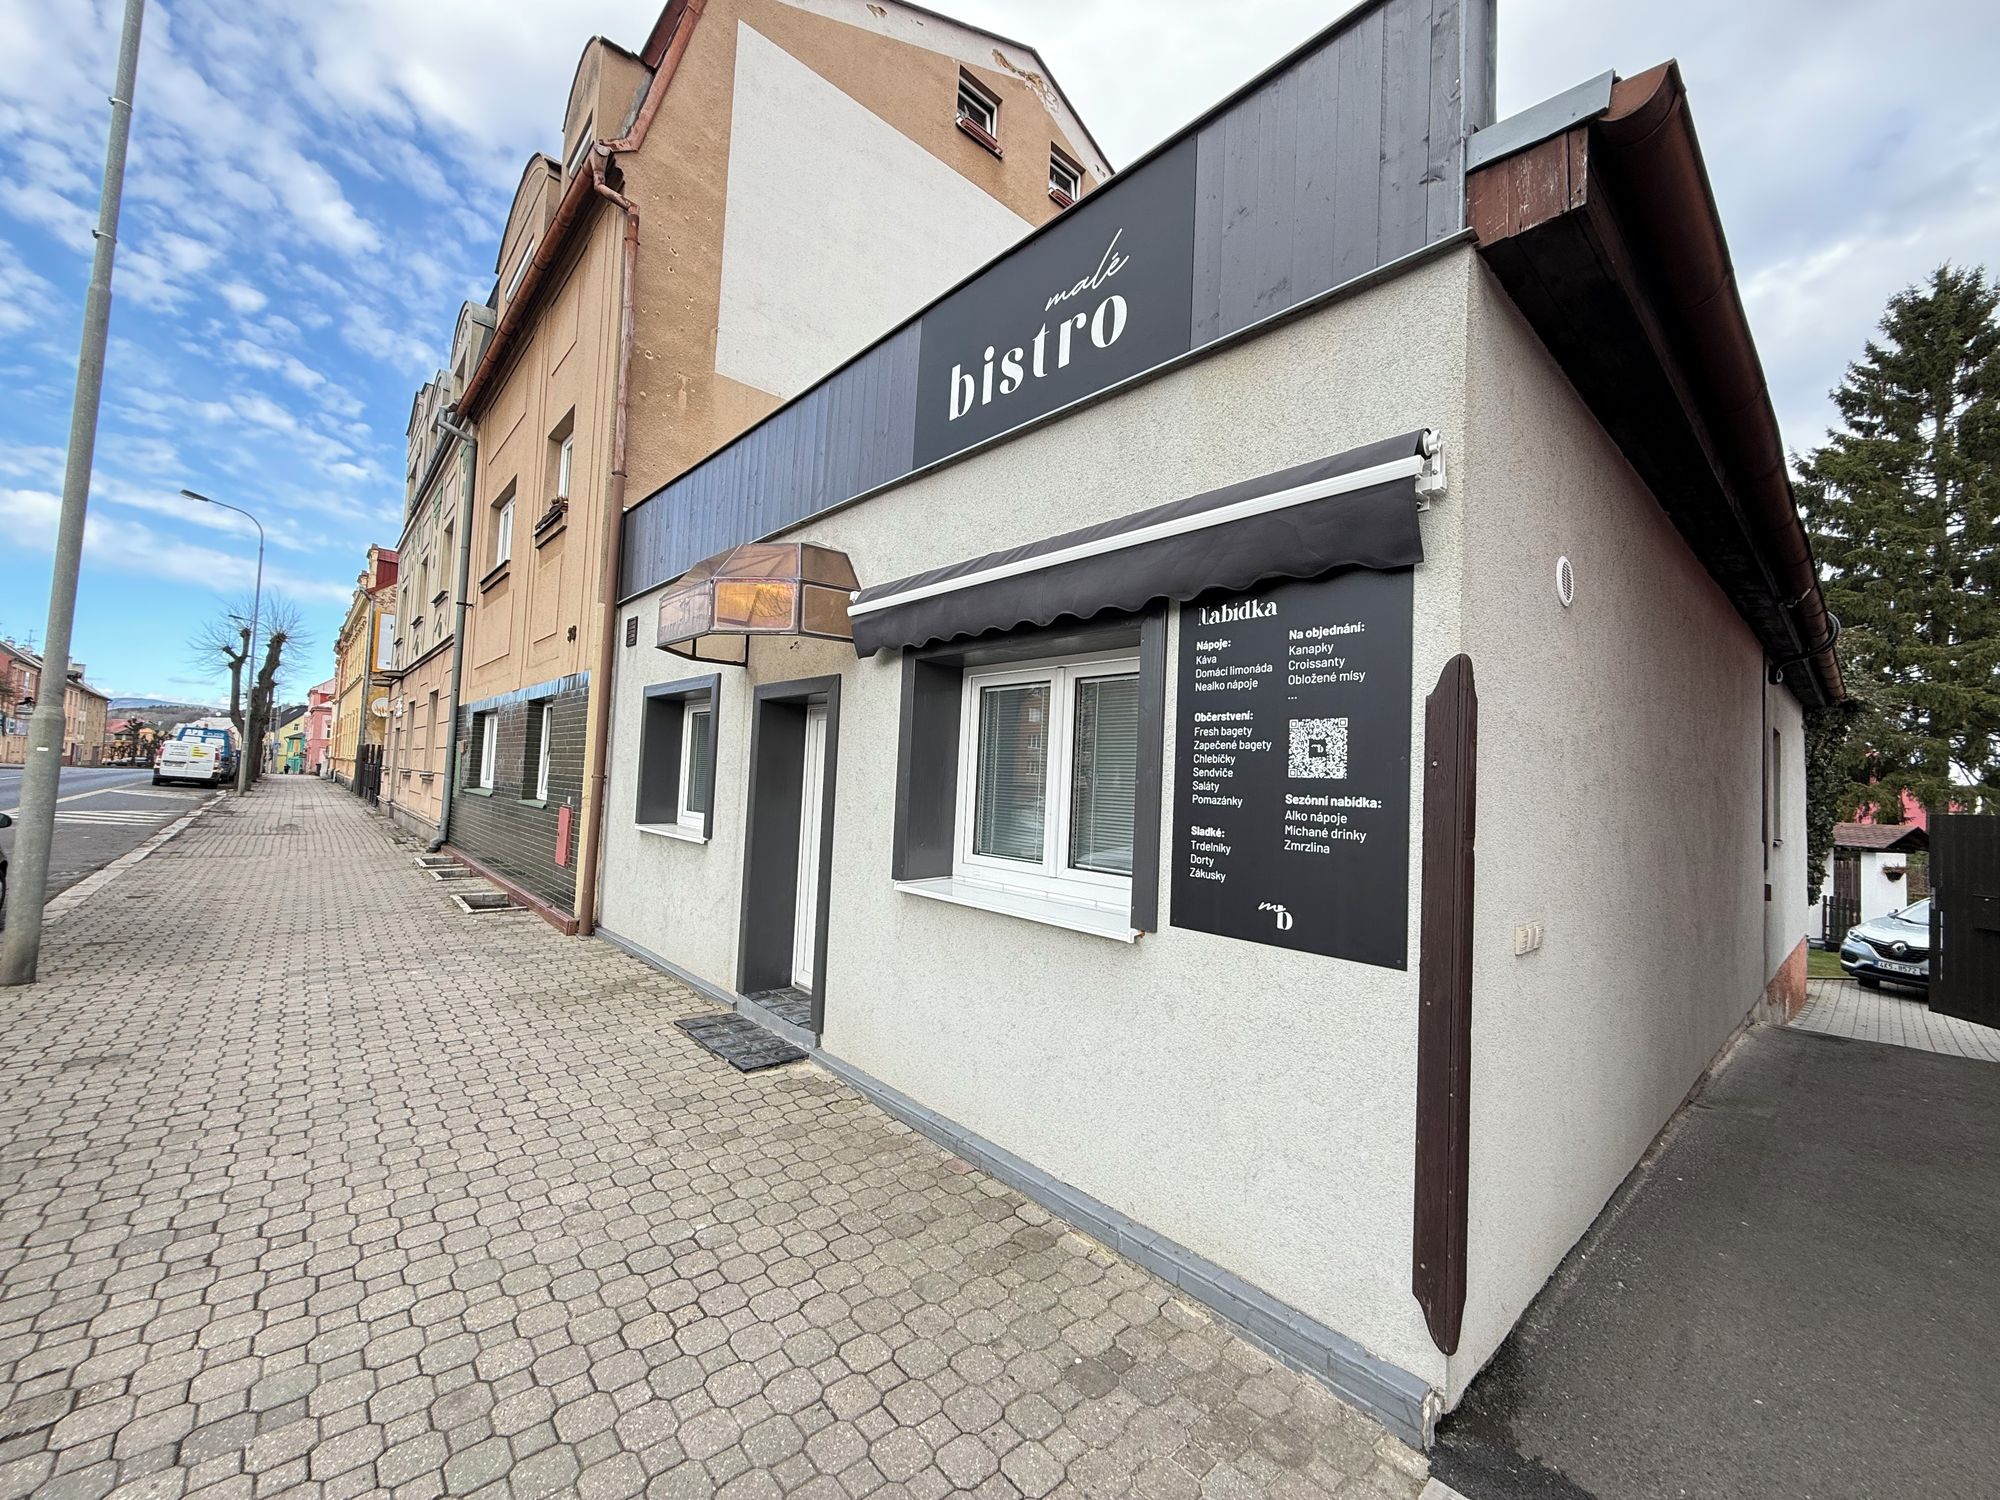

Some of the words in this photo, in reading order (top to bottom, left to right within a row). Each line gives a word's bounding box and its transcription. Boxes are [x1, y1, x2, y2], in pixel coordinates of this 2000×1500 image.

[1045, 228, 1129, 313] malé
[949, 293, 1129, 423] bistro
[1288, 630, 1303, 641] Na
[1305, 622, 1364, 640] objednání:
[1196, 639, 1231, 652] Nápoje:
[1288, 643, 1334, 656] Kanapky
[1195, 656, 1216, 665] Káva
[1288, 657, 1345, 671] Croissanty
[1195, 667, 1228, 679] Domácí
[1229, 663, 1272, 676] limonáda
[1287, 672, 1336, 686] Obložené
[1339, 670, 1365, 683] mísy
[1195, 682, 1225, 692] Nealko
[1226, 678, 1258, 691] nápoje
[1194, 711, 1253, 723] Občerstvení:
[1194, 727, 1219, 737] Fresh
[1220, 727, 1252, 739] bagety
[1193, 740, 1237, 752] Zapečené
[1238, 740, 1272, 752] bagety
[1193, 754, 1235, 766] Chlebíčky
[1192, 767, 1233, 778] Sendviče
[1192, 781, 1219, 793] Saláty
[1192, 794, 1243, 809] Pomazánky
[1284, 794, 1328, 807] Sezónní
[1330, 796, 1381, 809] nabídka:
[1284, 810, 1307, 822] Alko
[1309, 812, 1347, 827] nápoje
[1190, 826, 1225, 838] Sladké:
[1284, 825, 1328, 839] Míchané
[1330, 829, 1366, 844] drinky
[1283, 840, 1329, 854] Zmrzlina
[1189, 854, 1214, 867] Dorty
[1189, 866, 1226, 884] Zákusky
